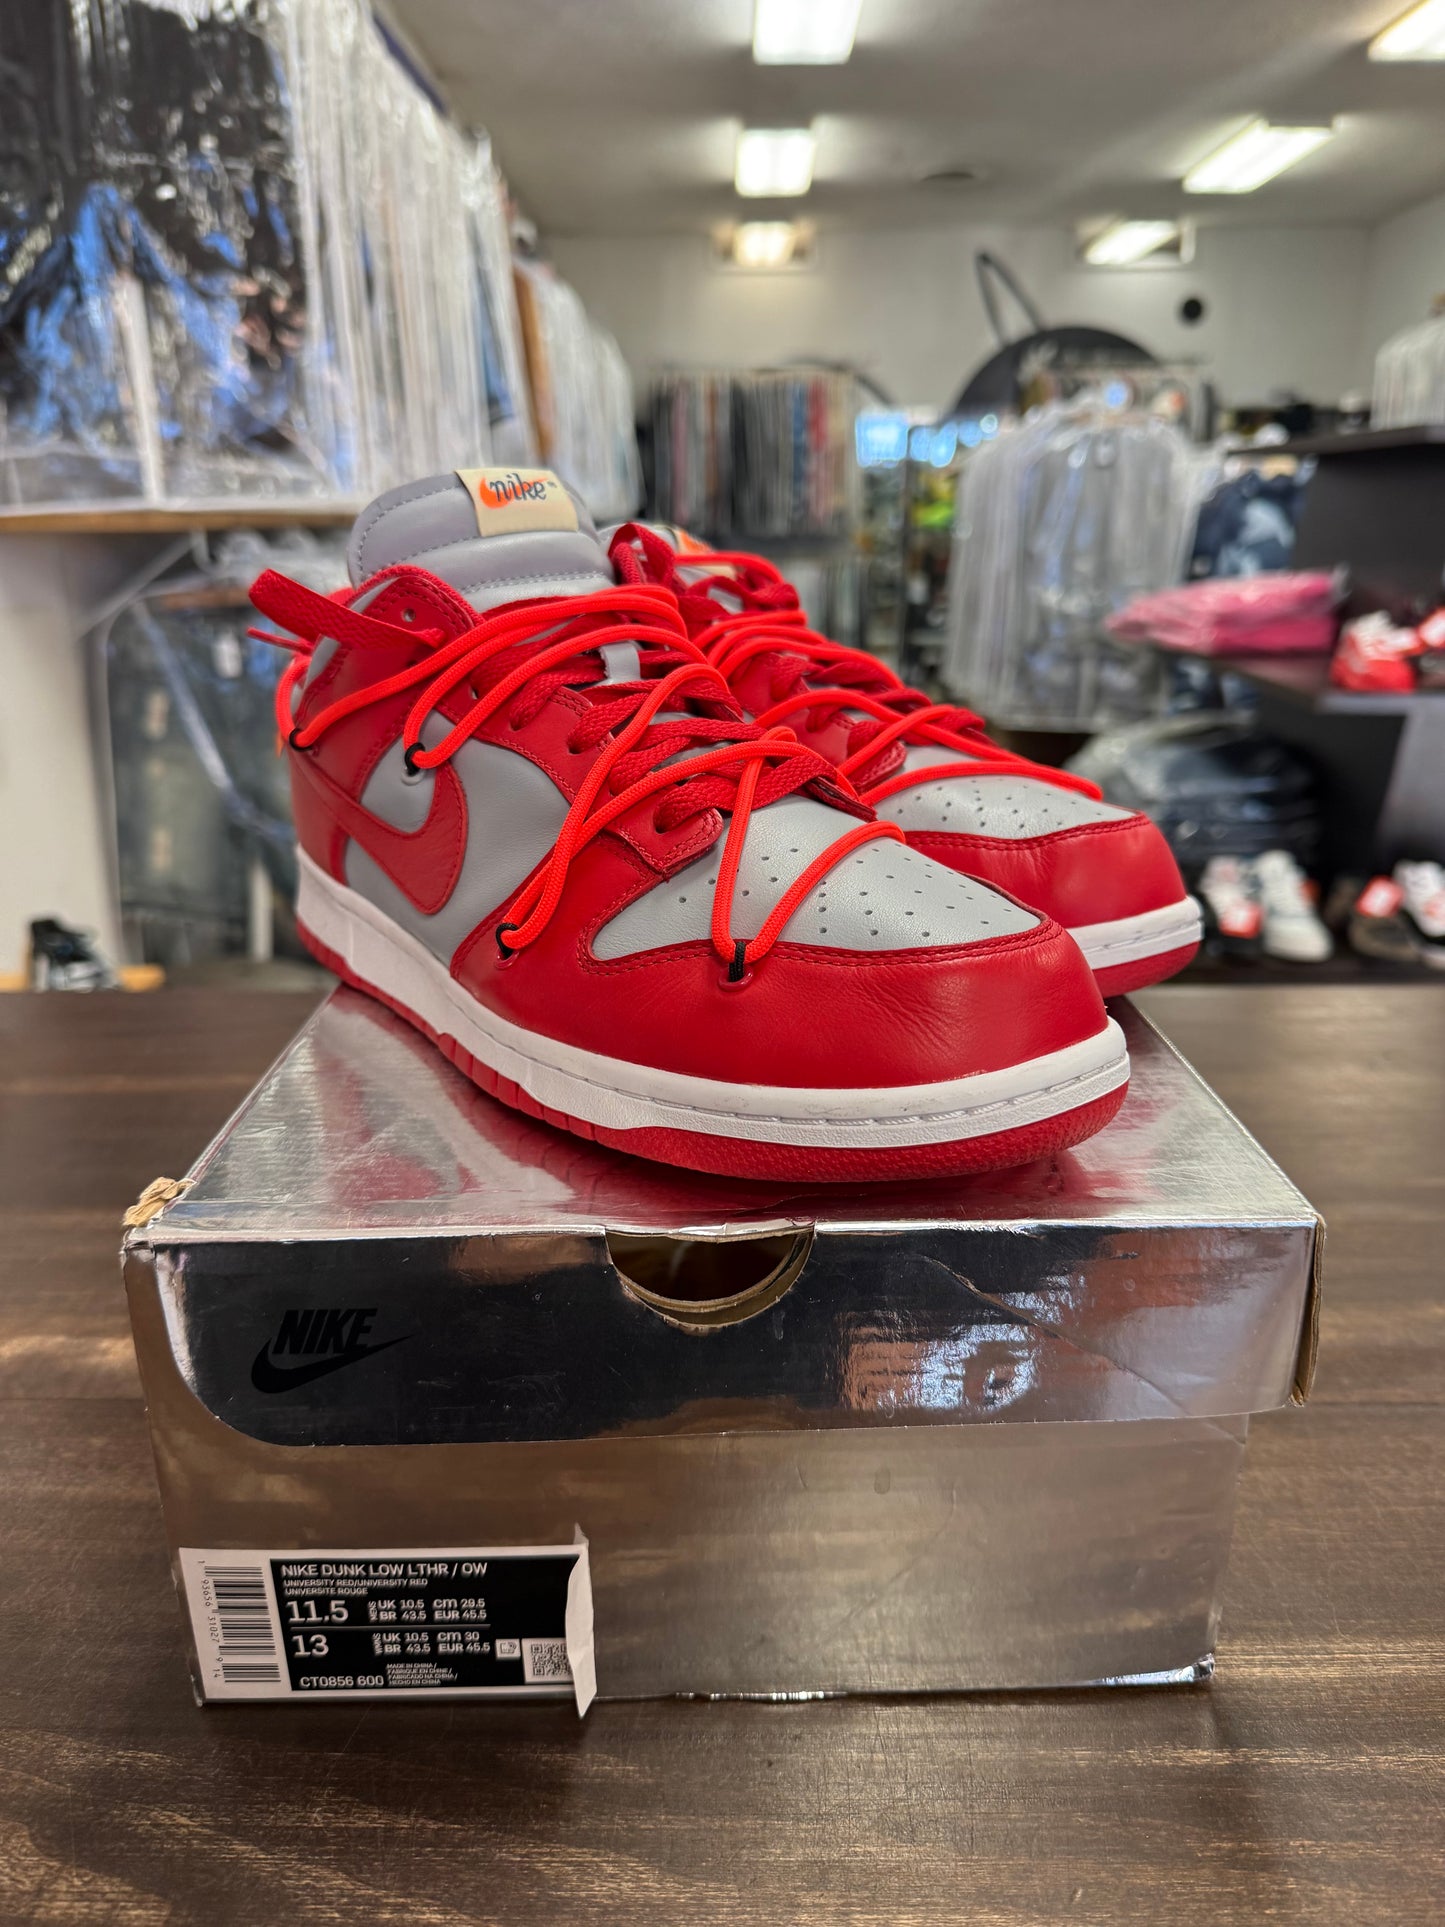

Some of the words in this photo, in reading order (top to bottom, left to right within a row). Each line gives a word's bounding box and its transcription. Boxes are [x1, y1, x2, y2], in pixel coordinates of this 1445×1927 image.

[489, 472, 547, 502] nike
[272, 1308, 378, 1354] NIKE
[281, 1563, 319, 1577] NIKE
[321, 1563, 367, 1577] DUNK
[369, 1562, 404, 1576] LOW
[408, 1562, 449, 1576] LTHR
[452, 1562, 458, 1578] /
[462, 1561, 488, 1575] OW
[284, 1578, 335, 1588] UNIVERSITY
[335, 1578, 408, 1587] RED/UNIVERSITY
[410, 1577, 428, 1586] RED
[285, 1587, 336, 1596] UNIVERSITE
[337, 1587, 368, 1596] ROUGE
[378, 1599, 397, 1609] UK
[400, 1598, 425, 1609] 10.5
[433, 1598, 458, 1609] cm
[286, 1599, 349, 1623] 11.5
[380, 1610, 397, 1620] BR
[401, 1610, 427, 1621] 43.5
[434, 1609, 460, 1620] EUR
[462, 1609, 487, 1619] 45.5
[382, 1632, 401, 1642] UK
[404, 1632, 429, 1642] 10.5
[437, 1631, 461, 1642] cm
[464, 1631, 479, 1641] 30
[291, 1634, 330, 1657] 13
[384, 1643, 401, 1654] BR
[406, 1643, 431, 1654] 43.5
[438, 1642, 464, 1653] EUR
[466, 1642, 490, 1652] 45.5
[299, 1676, 355, 1688] CT0856
[357, 1675, 384, 1687] 600
